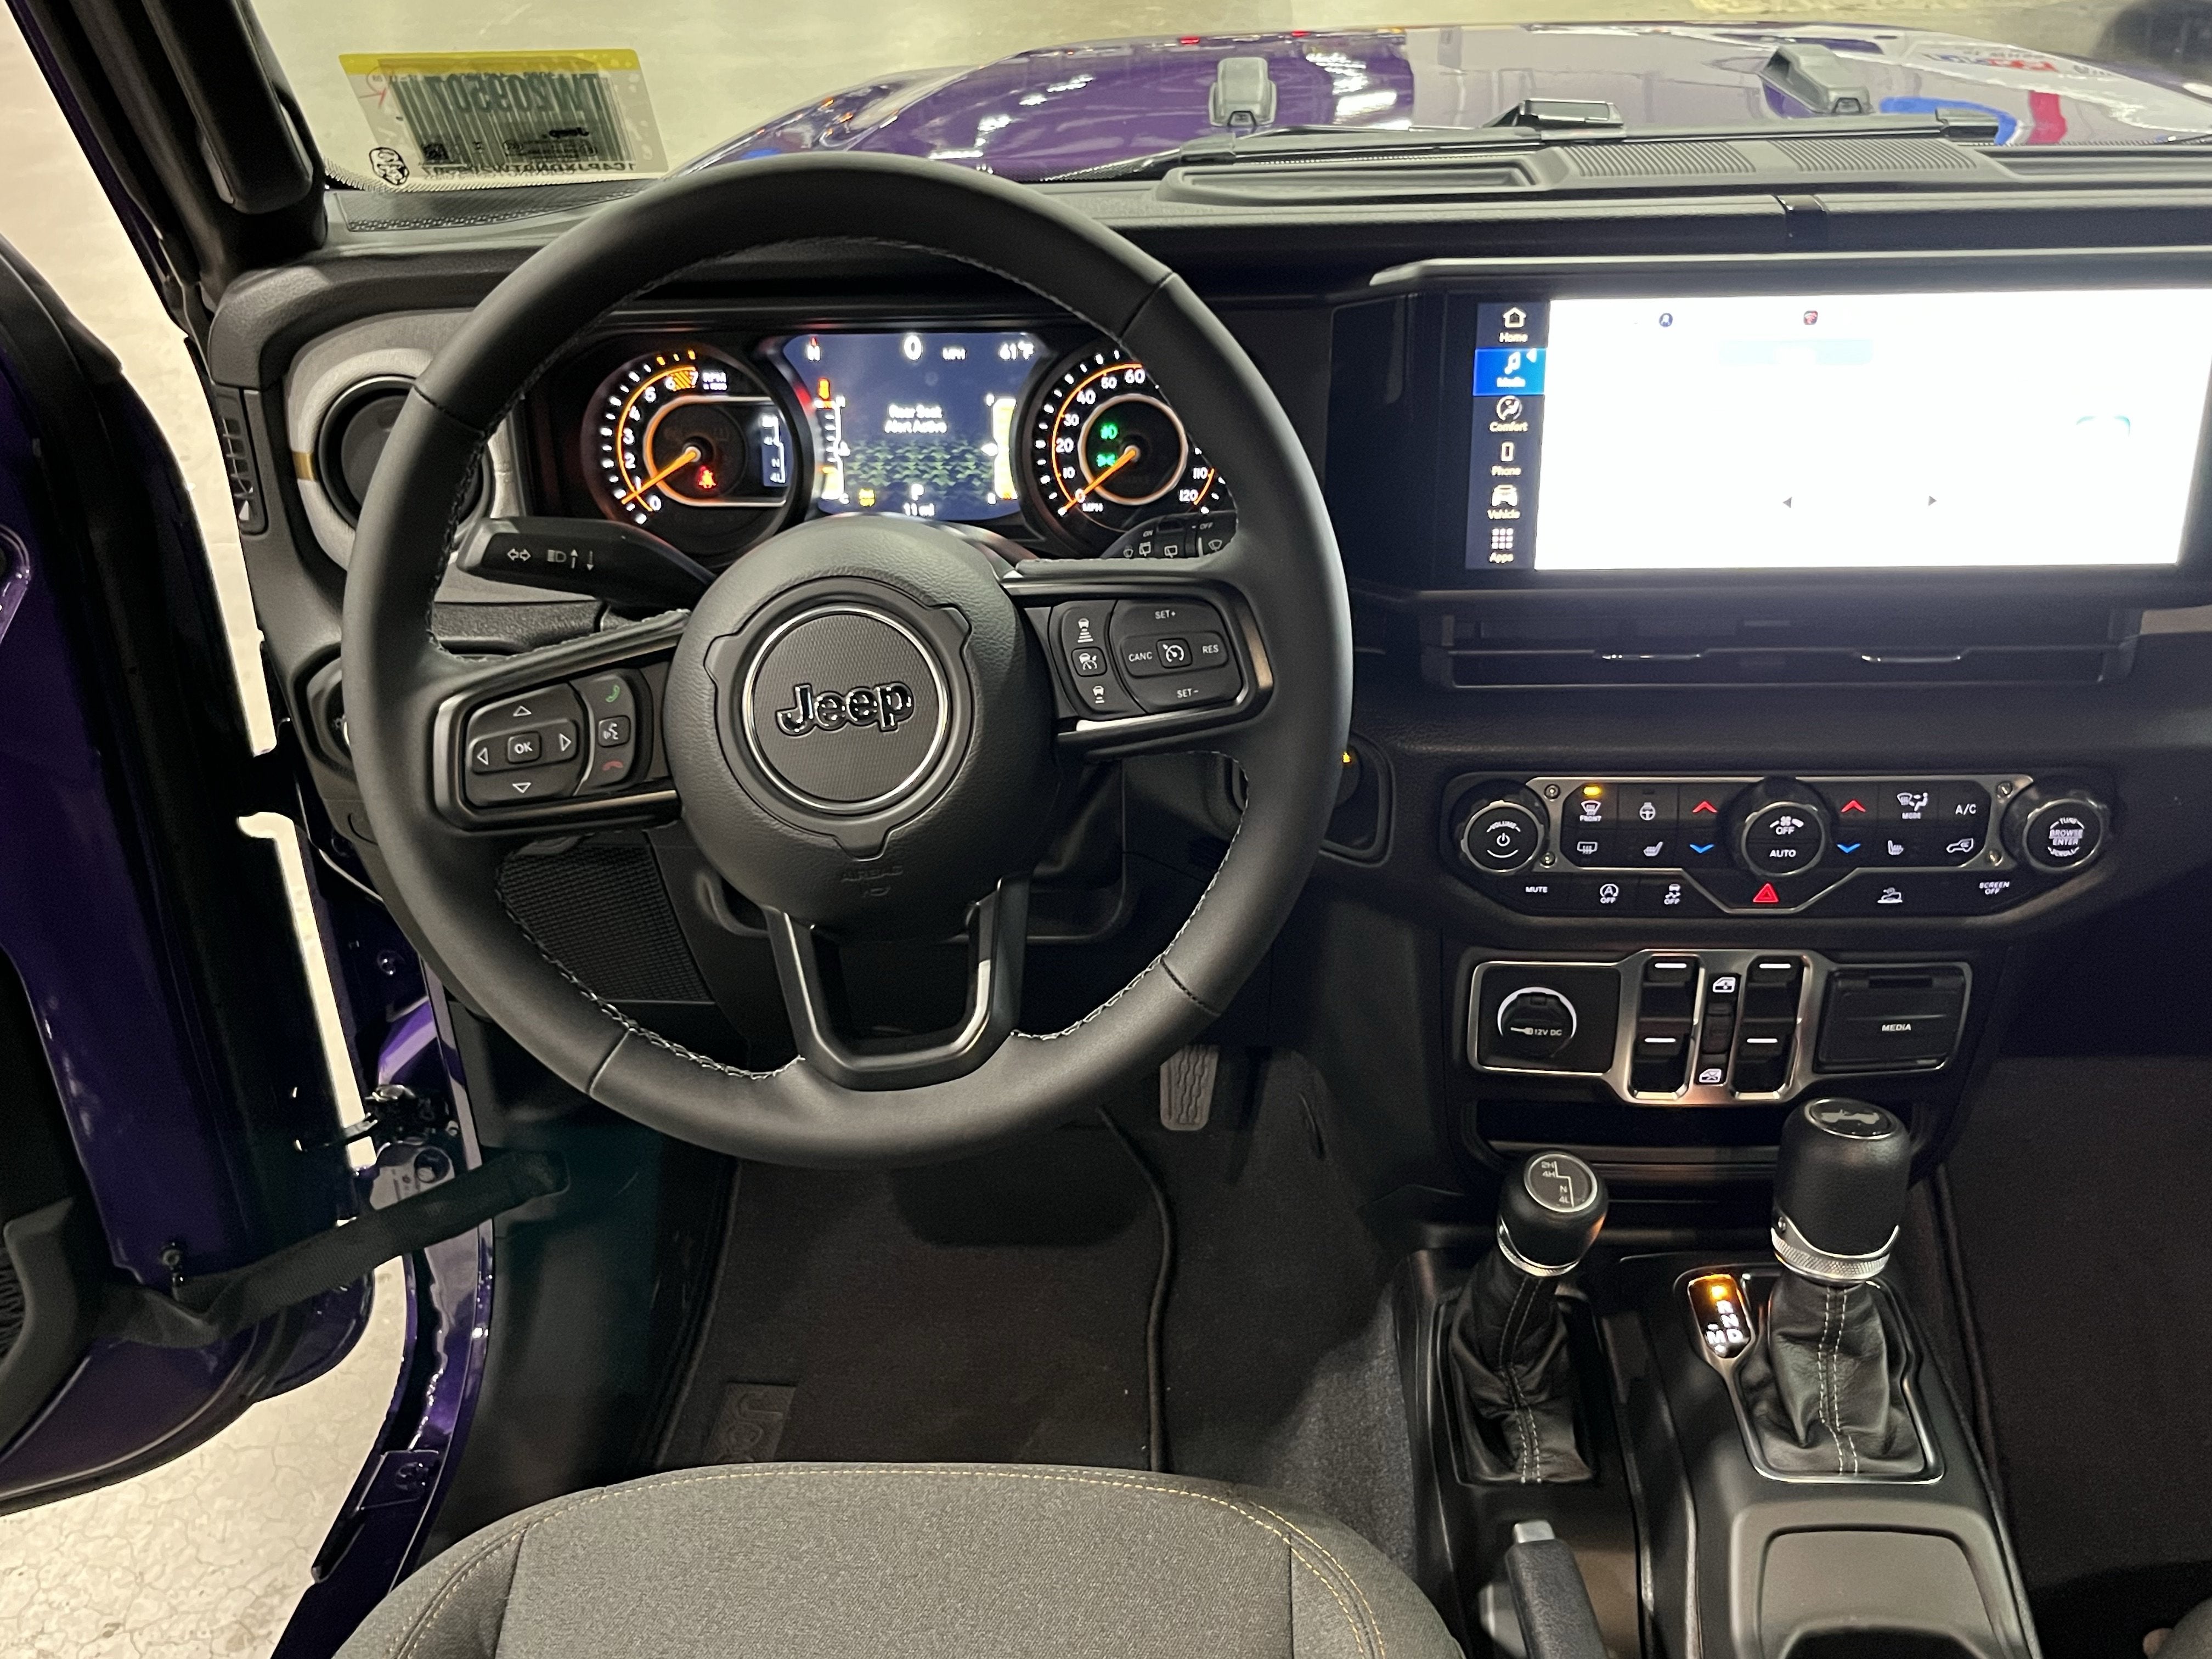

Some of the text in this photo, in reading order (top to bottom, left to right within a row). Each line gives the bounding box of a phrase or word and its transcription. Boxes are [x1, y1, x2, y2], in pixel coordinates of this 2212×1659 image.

[1499, 332, 1528, 343] Home
[1124, 369, 1146, 384] 60
[644, 386, 657, 403] 5
[1076, 390, 1096, 405] 40
[630, 406, 641, 421] 4
[1063, 413, 1080, 426] 30
[1489, 421, 1528, 432] Comfort
[623, 427, 635, 445] 3
[1056, 438, 1075, 453] 20
[624, 453, 636, 470] 2
[1063, 466, 1075, 478] 10
[1193, 466, 1207, 479] 110
[1491, 466, 1521, 476] Phone
[911, 483, 924, 501] P
[1179, 489, 1198, 503] 120
[650, 495, 662, 511] 0
[1487, 509, 1520, 520] Vehicle
[1489, 552, 1514, 563] Apps
[1202, 645, 1218, 654] RES
[1128, 651, 1153, 662] CANC
[775, 681, 915, 736] Jeep
[514, 741, 533, 754] OK
[1955, 803, 1977, 815] A/C
[1775, 826, 1795, 835] OFF
[1769, 849, 1797, 857] AUTO
[1560, 1185, 1567, 1193] N
[1720, 1313, 1739, 1328] N
[1706, 1330, 1726, 1344] M
